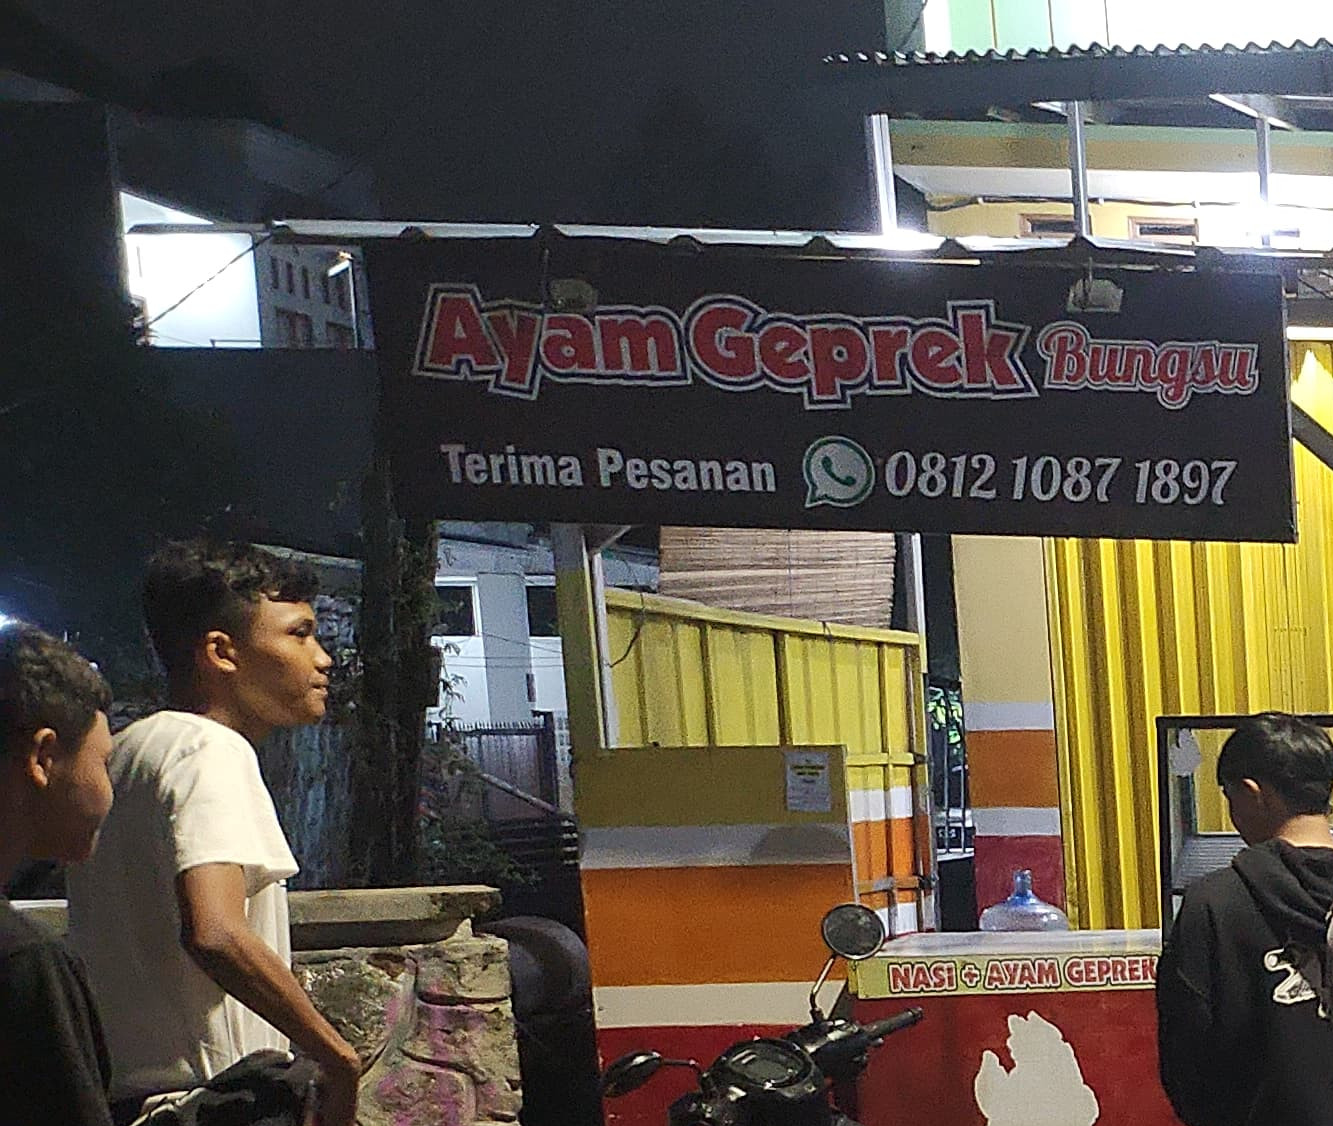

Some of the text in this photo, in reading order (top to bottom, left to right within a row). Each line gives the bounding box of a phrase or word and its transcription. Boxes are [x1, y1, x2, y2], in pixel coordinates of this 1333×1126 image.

[415, 285, 1259, 410] Ayam Geprek Bungsu
[440, 444, 776, 492] Terima Pesanan
[885, 451, 1237, 506] 0812 1087 1897
[889, 961, 957, 993] NASI
[984, 957, 1062, 988] AYAM
[1064, 954, 1158, 986] GEPREK
